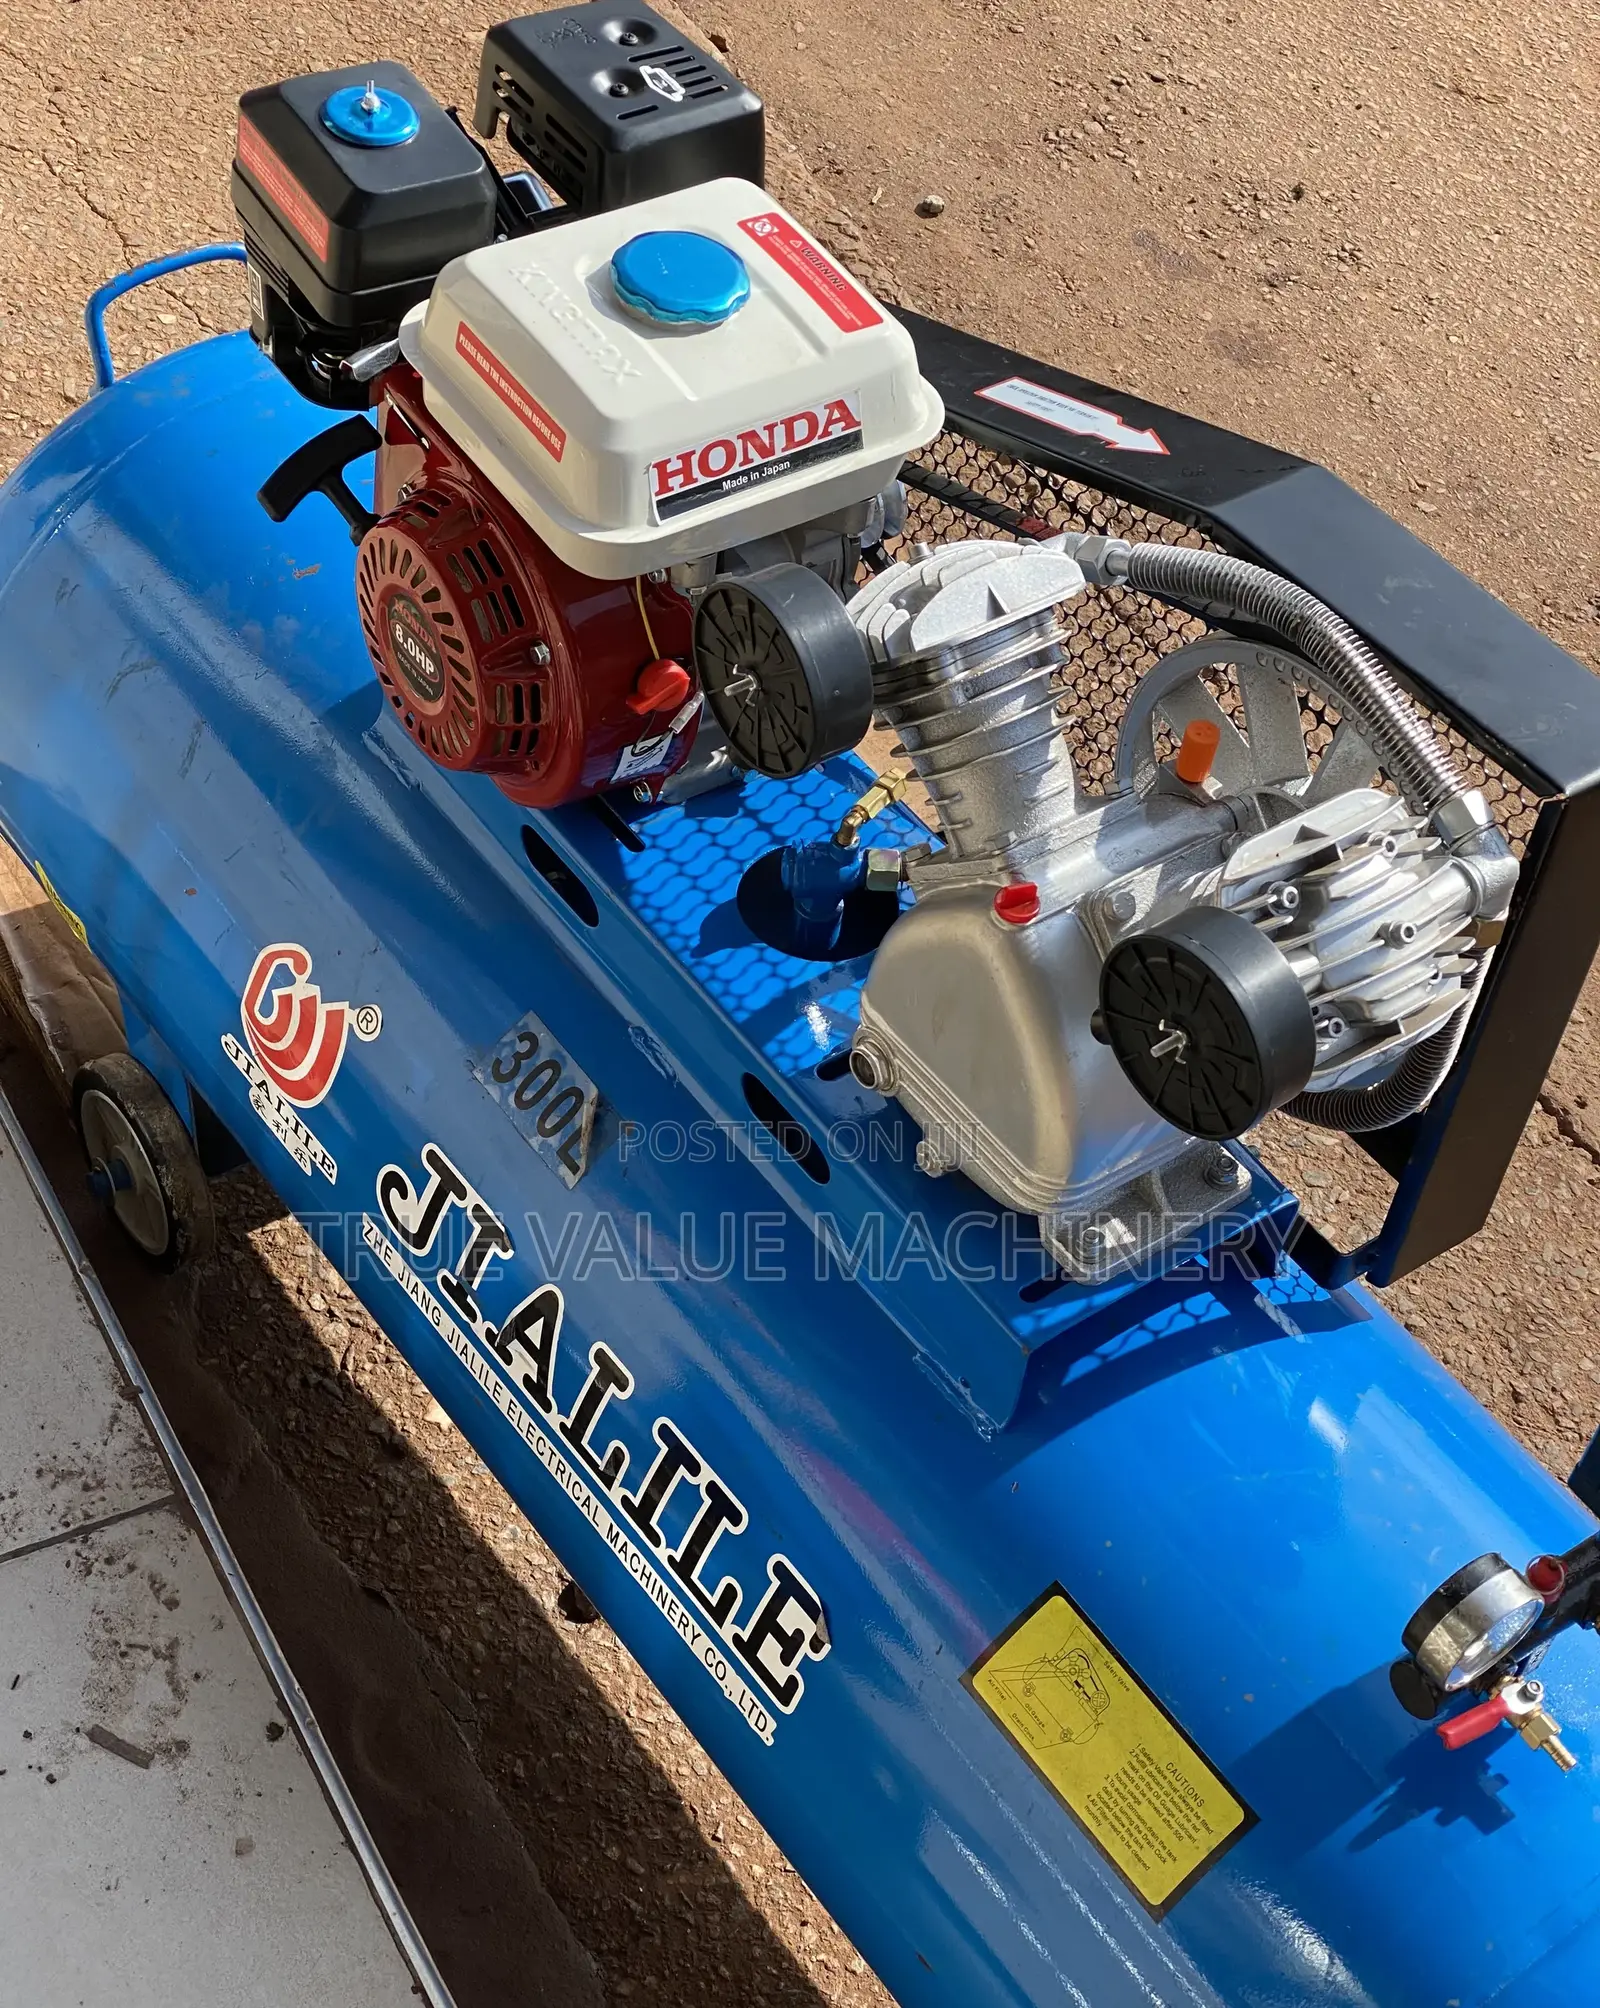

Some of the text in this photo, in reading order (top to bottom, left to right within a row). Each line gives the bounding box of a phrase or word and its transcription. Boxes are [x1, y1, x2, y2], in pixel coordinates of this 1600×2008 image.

[801, 247, 847, 291] WARNING
[459, 333, 562, 452] PLEASE READ THE INSTRUCTION BEFORE USE
[652, 399, 861, 496] HONDA
[722, 460, 790, 491] Made in Japan
[395, 623, 435, 675] 8.0HP
[225, 1040, 335, 1179] JIALILE
[381, 1146, 829, 1709] JIALILE
[360, 1221, 396, 1266] ZHE
[396, 1265, 445, 1327] JIANG
[445, 1327, 506, 1404] JIALILE
[503, 1398, 605, 1526] ELECTRICAL
[602, 1523, 702, 1647] MACHINERY
[735, 1688, 776, 1741] LTD.
[1082, 1804, 1103, 1828] monthly
[1095, 1791, 1114, 1813] located
[1111, 1810, 1127, 1829] below
[1113, 1772, 1142, 1807] hours usage
[1119, 1765, 1136, 1784] needs
[1161, 1815, 1175, 1831] after
[1172, 1828, 1184, 1842] 500
[1126, 1758, 1141, 1775] mark
[1144, 1780, 1154, 1792] the
[1173, 1816, 1197, 1843] Lubricant
[1153, 1763, 1168, 1780] Valve
[1165, 1778, 1179, 1794] must
[1176, 1792, 1195, 1814] always
[1192, 1810, 1202, 1821] be
[1199, 1818, 1214, 1834] fitted
[1164, 1761, 1205, 1808] CAUTIONS
[1168, 1795, 1185, 1814] below
[1182, 1812, 1193, 1824] the
[1189, 1821, 1200, 1833] red
[1100, 1784, 1114, 1801] daily
[1116, 1805, 1135, 1827] turning
[1133, 1823, 1143, 1835] the
[1140, 1832, 1156, 1850] Drain
[1153, 1847, 1168, 1865] Cock
[1113, 1786, 1128, 1803] avoid
[1157, 1838, 1168, 1851] the
[1130, 1847, 1151, 1871] cleaned
